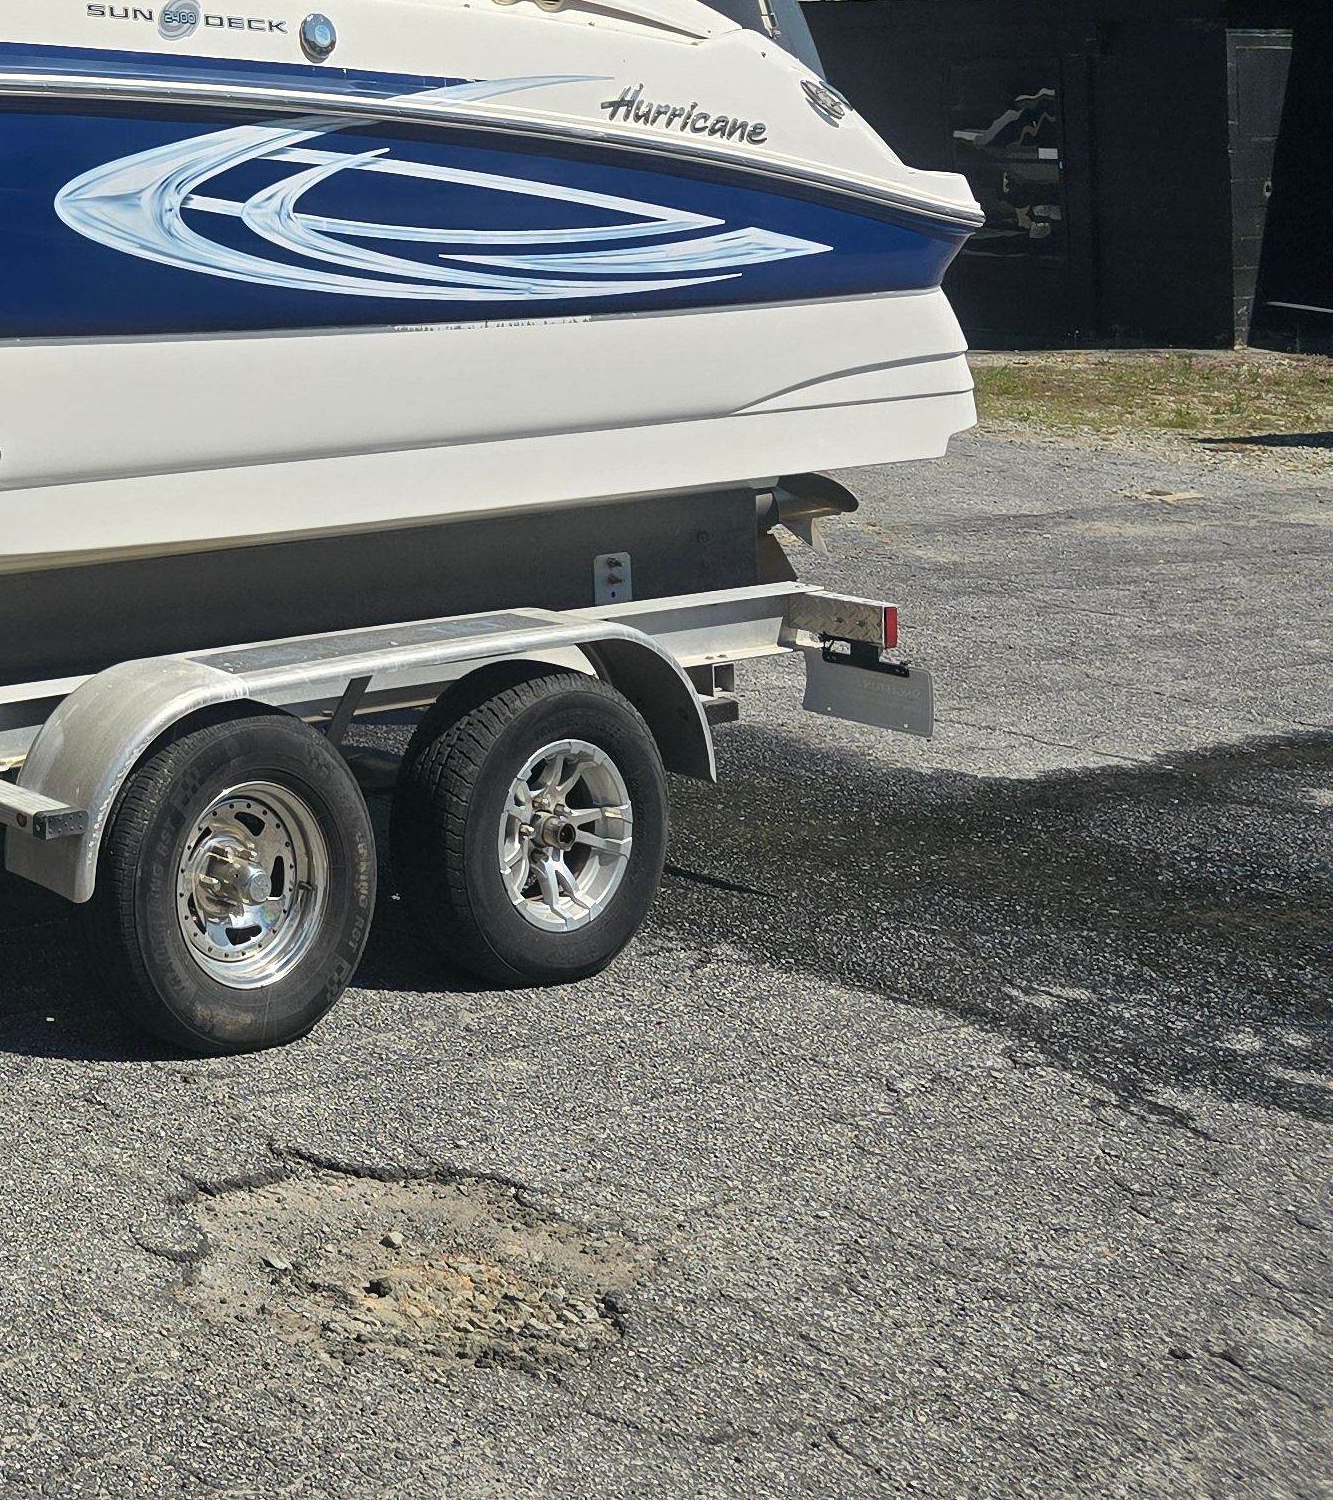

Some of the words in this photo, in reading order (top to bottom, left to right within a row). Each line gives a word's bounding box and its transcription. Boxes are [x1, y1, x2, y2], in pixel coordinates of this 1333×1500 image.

[87, 3, 154, 22] SUN
[163, 9, 197, 25] 2400
[204, 14, 288, 34] DECK
[600, 83, 768, 145] Hurricane
